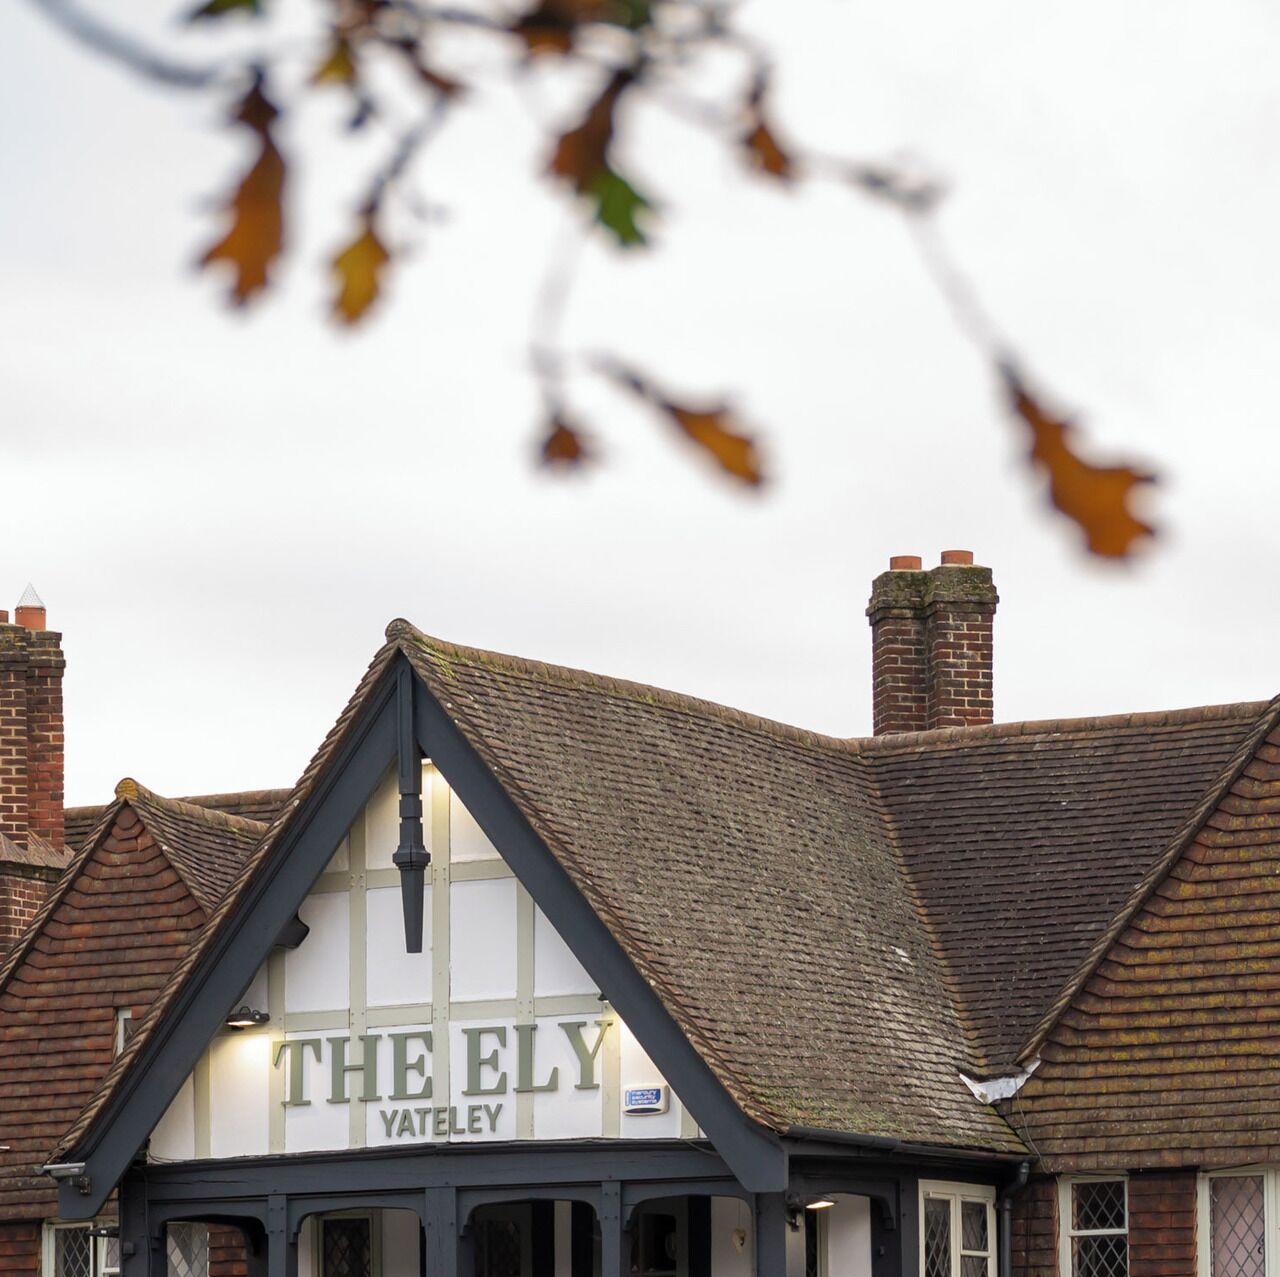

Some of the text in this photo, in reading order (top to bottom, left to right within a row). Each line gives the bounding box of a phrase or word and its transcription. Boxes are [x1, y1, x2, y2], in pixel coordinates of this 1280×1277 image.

[272, 1019, 614, 1106] THE ELY
[380, 1103, 503, 1138] YATELEY
